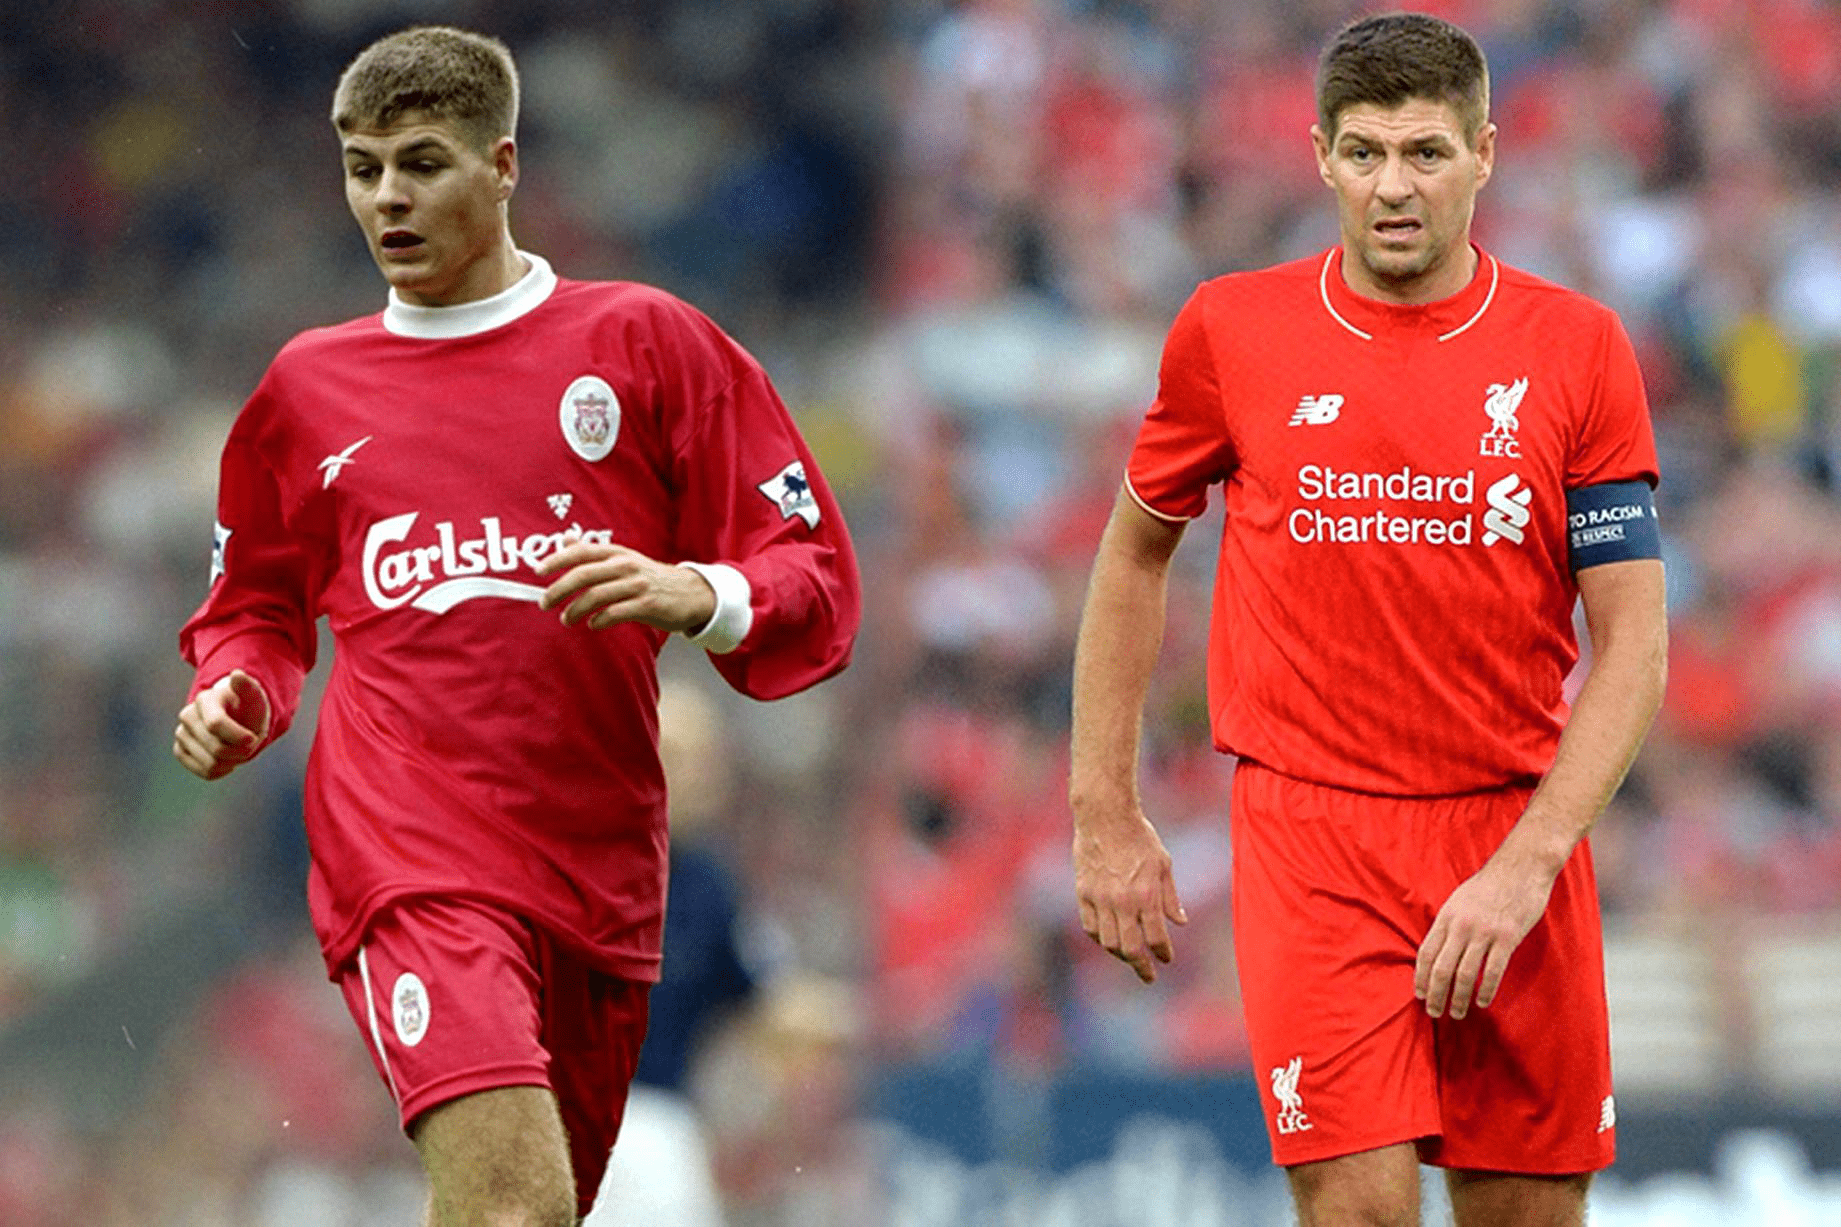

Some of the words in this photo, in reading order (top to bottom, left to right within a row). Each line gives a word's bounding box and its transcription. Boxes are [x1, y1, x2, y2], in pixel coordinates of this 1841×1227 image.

[1298, 464, 1475, 504] Standard
[1288, 508, 1472, 546] Chartered
[1588, 505, 1645, 525] RACISM
